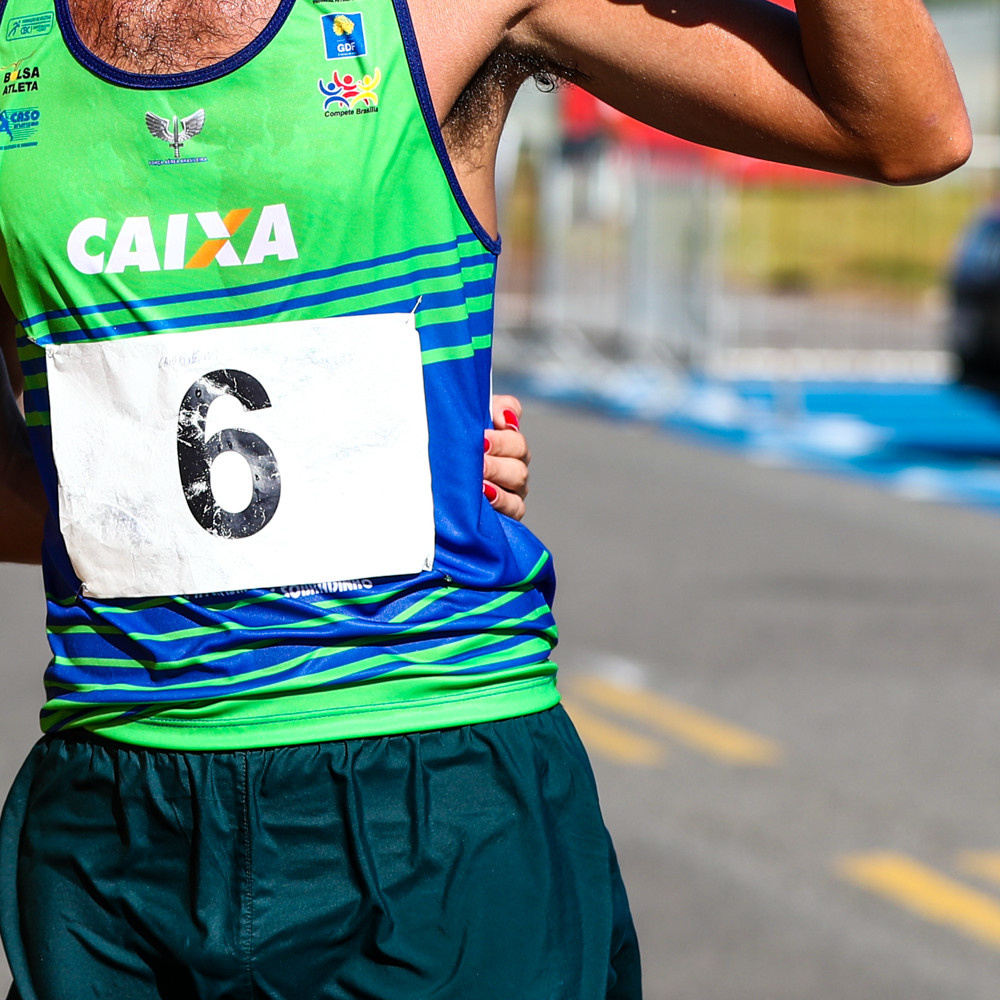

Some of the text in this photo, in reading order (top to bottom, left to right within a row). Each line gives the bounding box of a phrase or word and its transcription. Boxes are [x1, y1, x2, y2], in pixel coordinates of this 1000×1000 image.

[336, 42, 356, 52] GDF
[2, 81, 39, 96] ATLETA
[324, 109, 355, 118] Compete
[66, 203, 299, 275] CAIXA
[176, 368, 282, 540] 6
